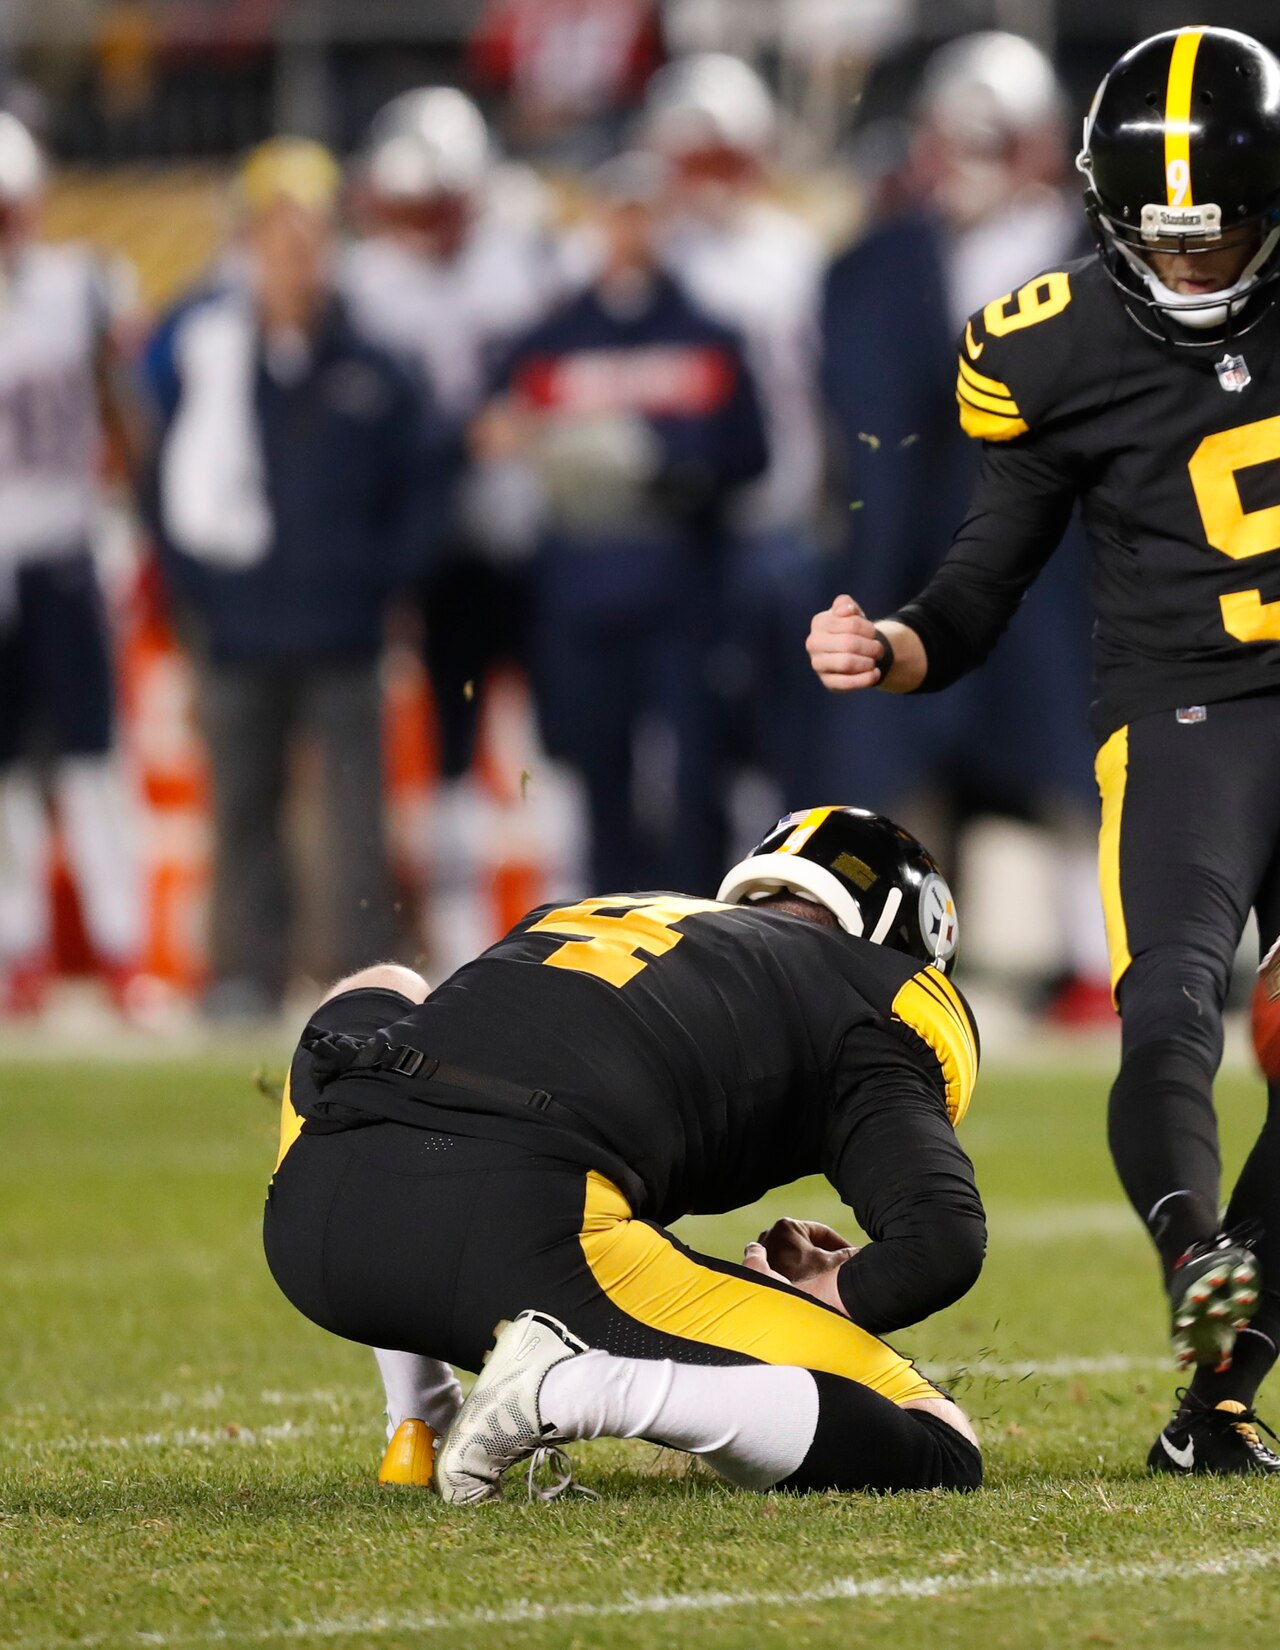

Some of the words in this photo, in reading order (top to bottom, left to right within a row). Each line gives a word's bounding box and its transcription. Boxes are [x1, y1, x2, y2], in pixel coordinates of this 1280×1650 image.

[1167, 159, 1190, 205] 9
[1160, 212, 1201, 225] Steelers
[984, 272, 1071, 337] 9
[524, 896, 744, 989] 4
